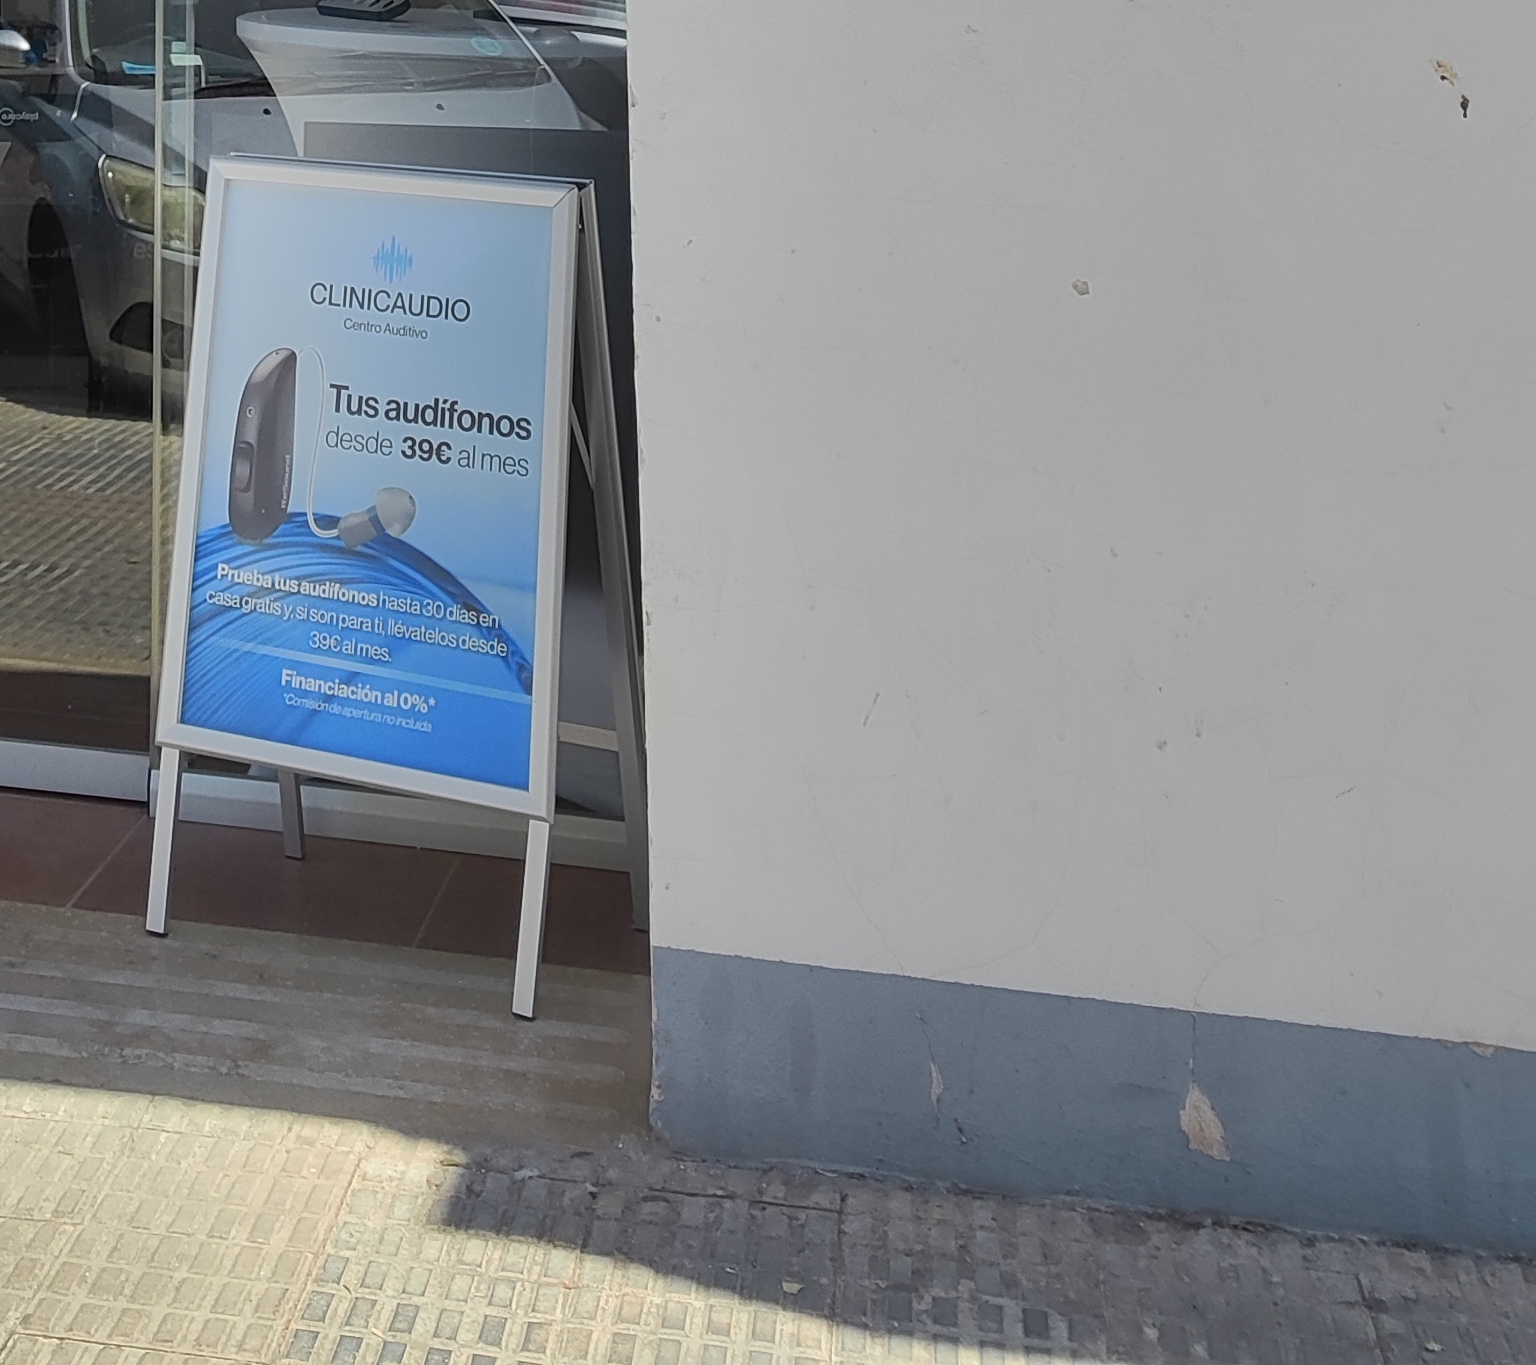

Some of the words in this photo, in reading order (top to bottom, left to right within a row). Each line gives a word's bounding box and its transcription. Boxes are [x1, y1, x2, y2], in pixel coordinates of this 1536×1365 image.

[309, 282, 472, 323] CLINICAUDIO
[343, 317, 382, 335] Centro
[383, 322, 429, 340] Auditivo
[329, 382, 380, 419] Tus
[383, 397, 533, 441] audífonos
[325, 425, 394, 457] desde
[400, 435, 453, 466] 39€
[457, 444, 477, 470] al
[480, 450, 530, 478] mes
[216, 562, 272, 589] Prueba
[274, 574, 299, 593] tus
[299, 580, 378, 607] audífonos
[379, 590, 421, 616] hasta
[422, 598, 445, 619] 30
[446, 603, 478, 625] días
[479, 613, 500, 629] en
[205, 590, 241, 609] casa
[241, 596, 282, 616] gratis
[295, 603, 309, 620] si
[309, 608, 337, 625] son
[338, 613, 372, 633] para
[388, 618, 457, 648] llévatelos
[458, 633, 508, 657] desde
[309, 630, 341, 651] 39€
[342, 636, 355, 655] al
[357, 642, 392, 663] mes.
[281, 668, 382, 704] Financiación
[383, 689, 398, 708] al
